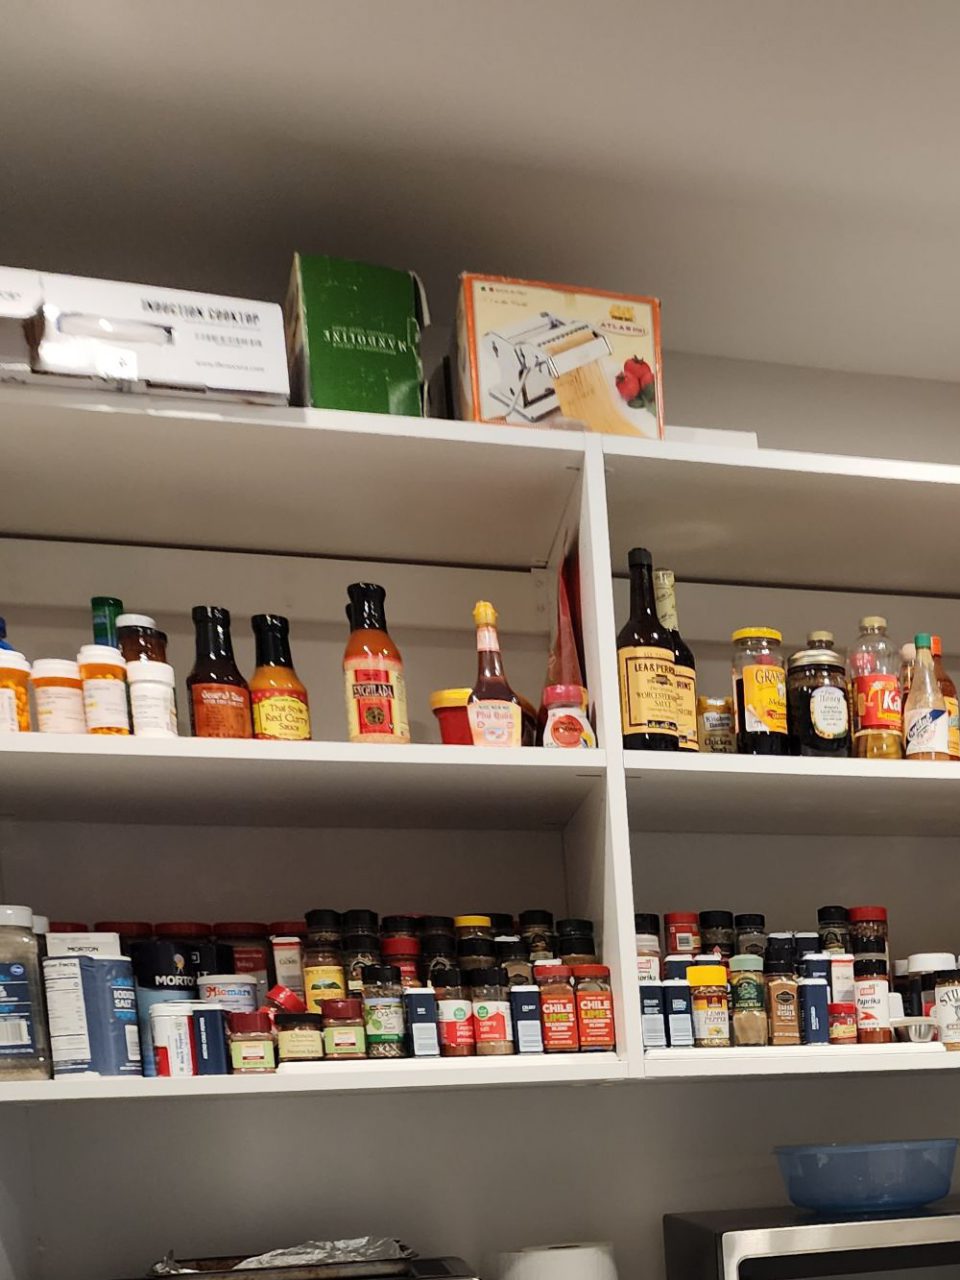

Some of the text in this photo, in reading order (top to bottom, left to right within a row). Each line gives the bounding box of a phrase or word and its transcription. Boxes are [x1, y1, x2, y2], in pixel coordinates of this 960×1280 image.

[142, 299, 261, 326] INDUCTION COOKTOP
[353, 684, 393, 697] ENCHILADA
[883, 691, 902, 710] Ka
[580, 1000, 611, 1011] CHILE
[857, 998, 881, 1007] Paprika
[542, 1003, 573, 1014] CHILE
[581, 1009, 606, 1019] LIME
[544, 1013, 569, 1023] LIME
